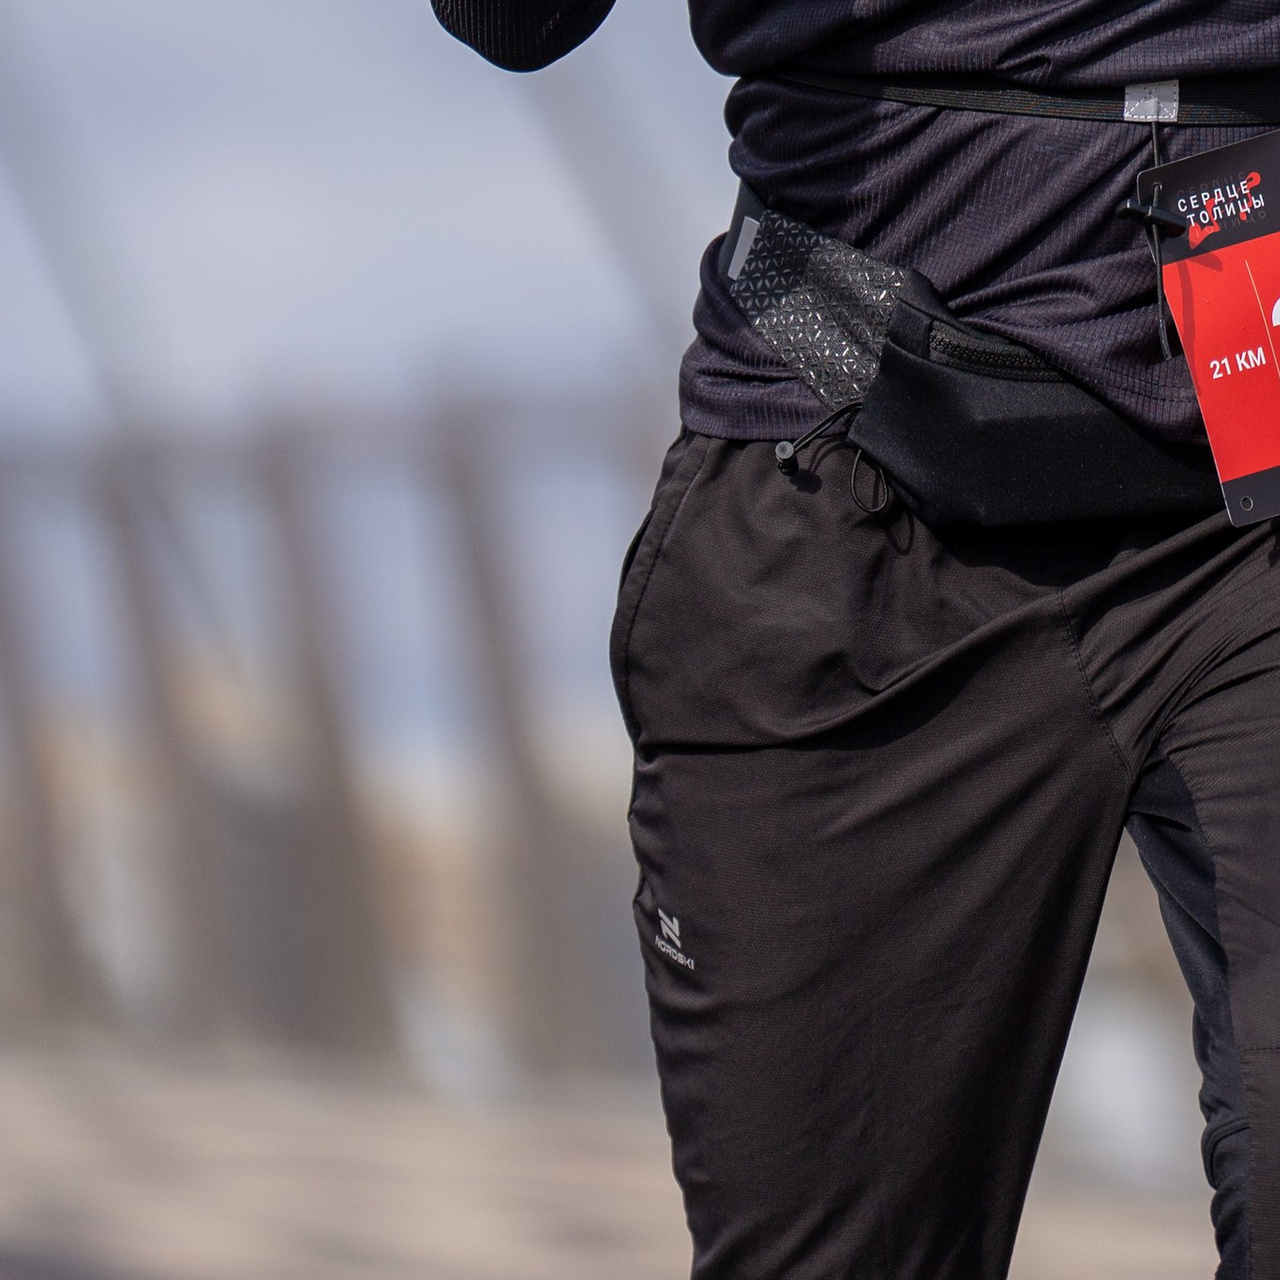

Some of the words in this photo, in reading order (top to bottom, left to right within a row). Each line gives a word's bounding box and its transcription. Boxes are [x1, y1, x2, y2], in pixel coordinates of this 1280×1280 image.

[1177, 180, 1250, 212] СЕРДЦЕ
[1186, 194, 1265, 227] ТОЛИЦЫ
[1209, 356, 1232, 380] 21
[1235, 346, 1266, 372] КМ
[655, 934, 695, 971] NORDSKI
